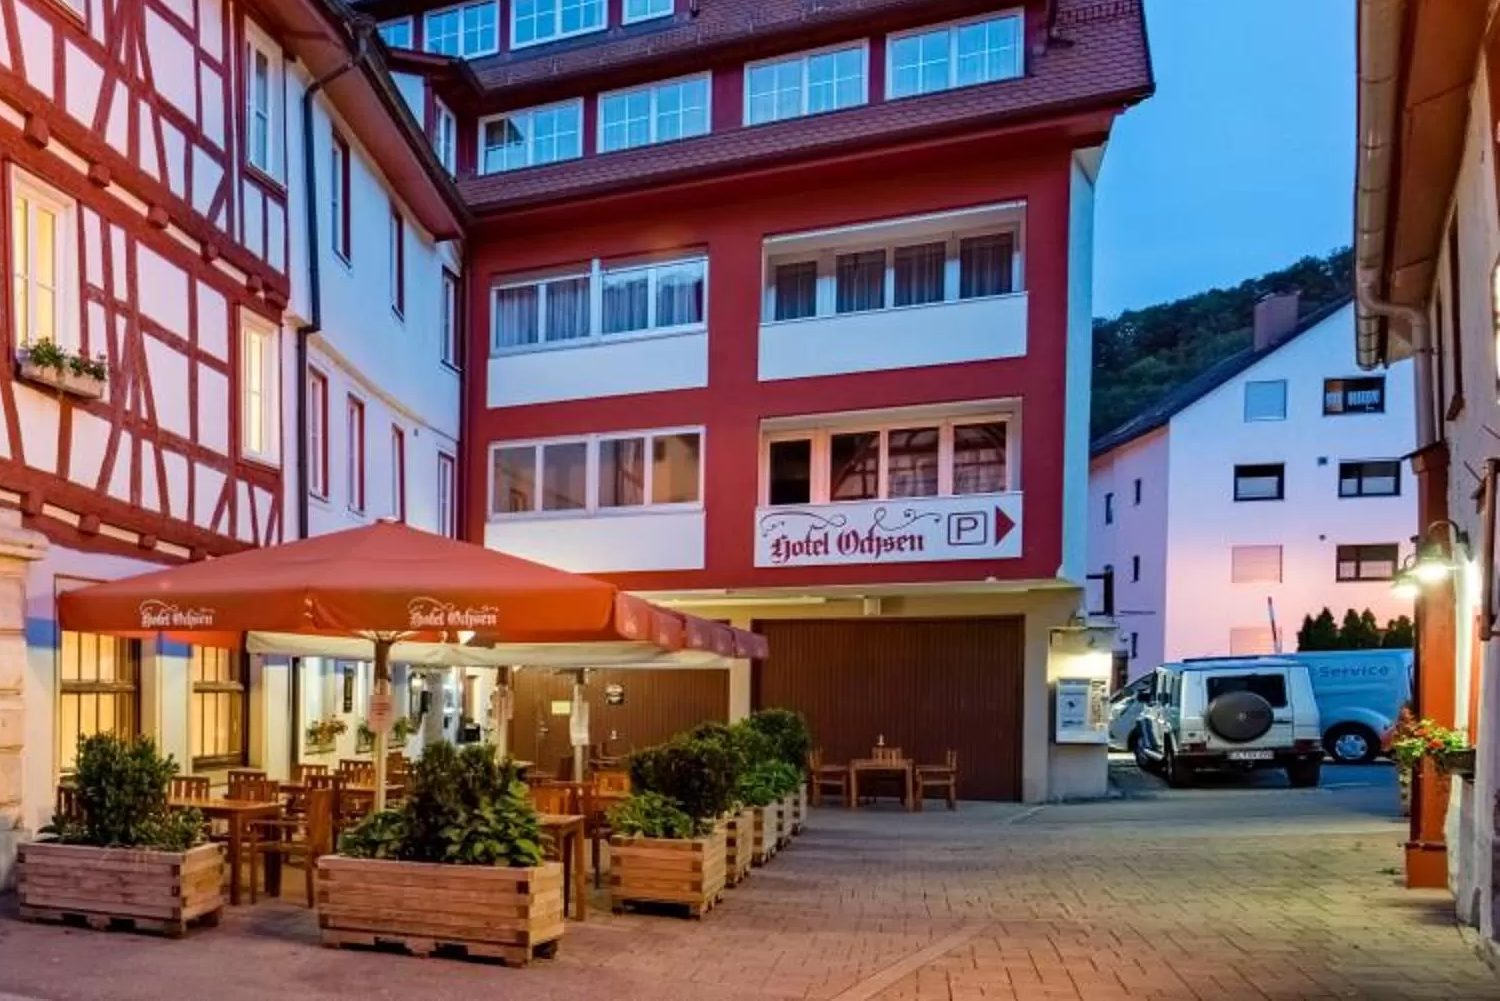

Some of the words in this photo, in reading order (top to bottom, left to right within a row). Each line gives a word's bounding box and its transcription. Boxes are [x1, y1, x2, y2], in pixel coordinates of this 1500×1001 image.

[771, 524, 830, 564] Hotel
[836, 523, 924, 559] Ochsen
[956, 516, 979, 540] P
[1319, 666, 1389, 678] Service
